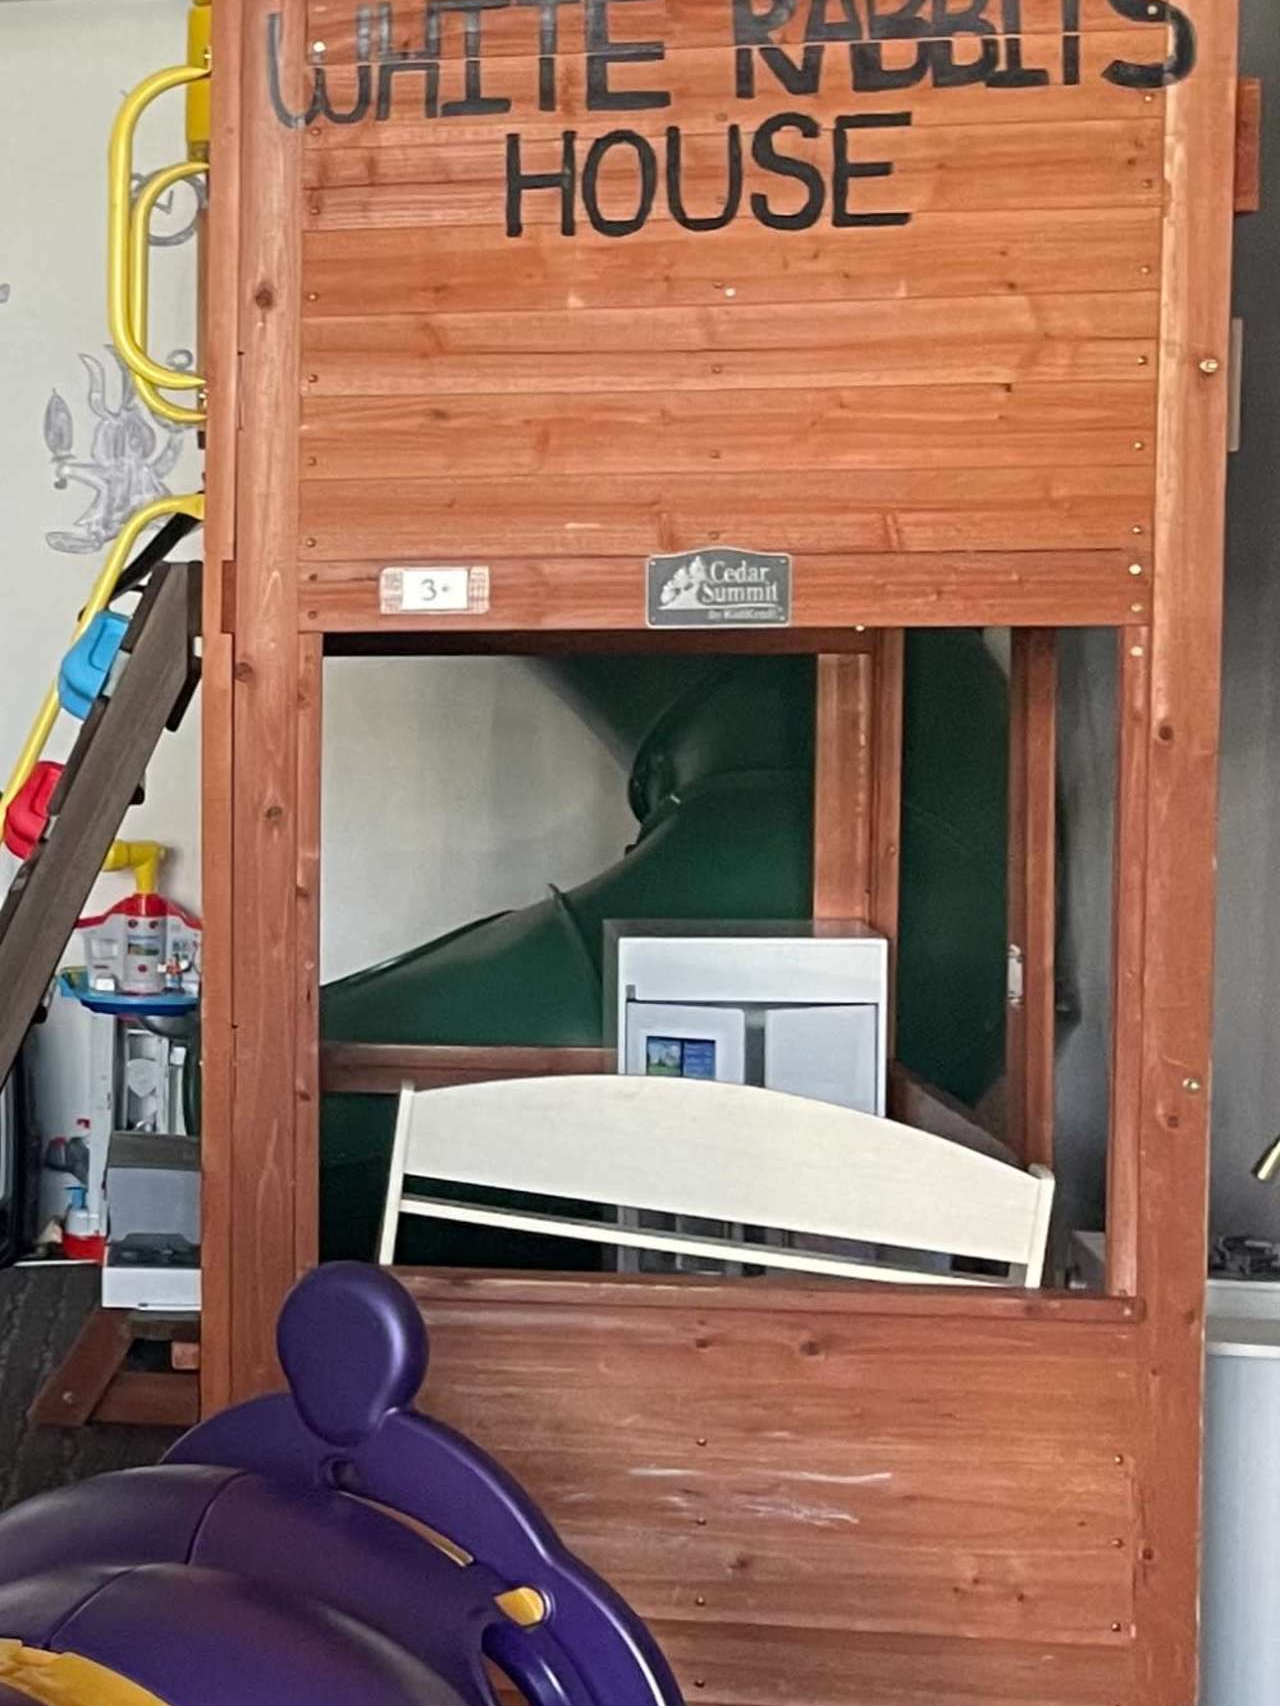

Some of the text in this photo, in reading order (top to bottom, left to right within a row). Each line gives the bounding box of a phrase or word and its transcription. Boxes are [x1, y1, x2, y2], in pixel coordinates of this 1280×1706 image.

[505, 111, 913, 238] HOUSE
[710, 559, 771, 584] Cedar
[700, 581, 779, 604] Summit
